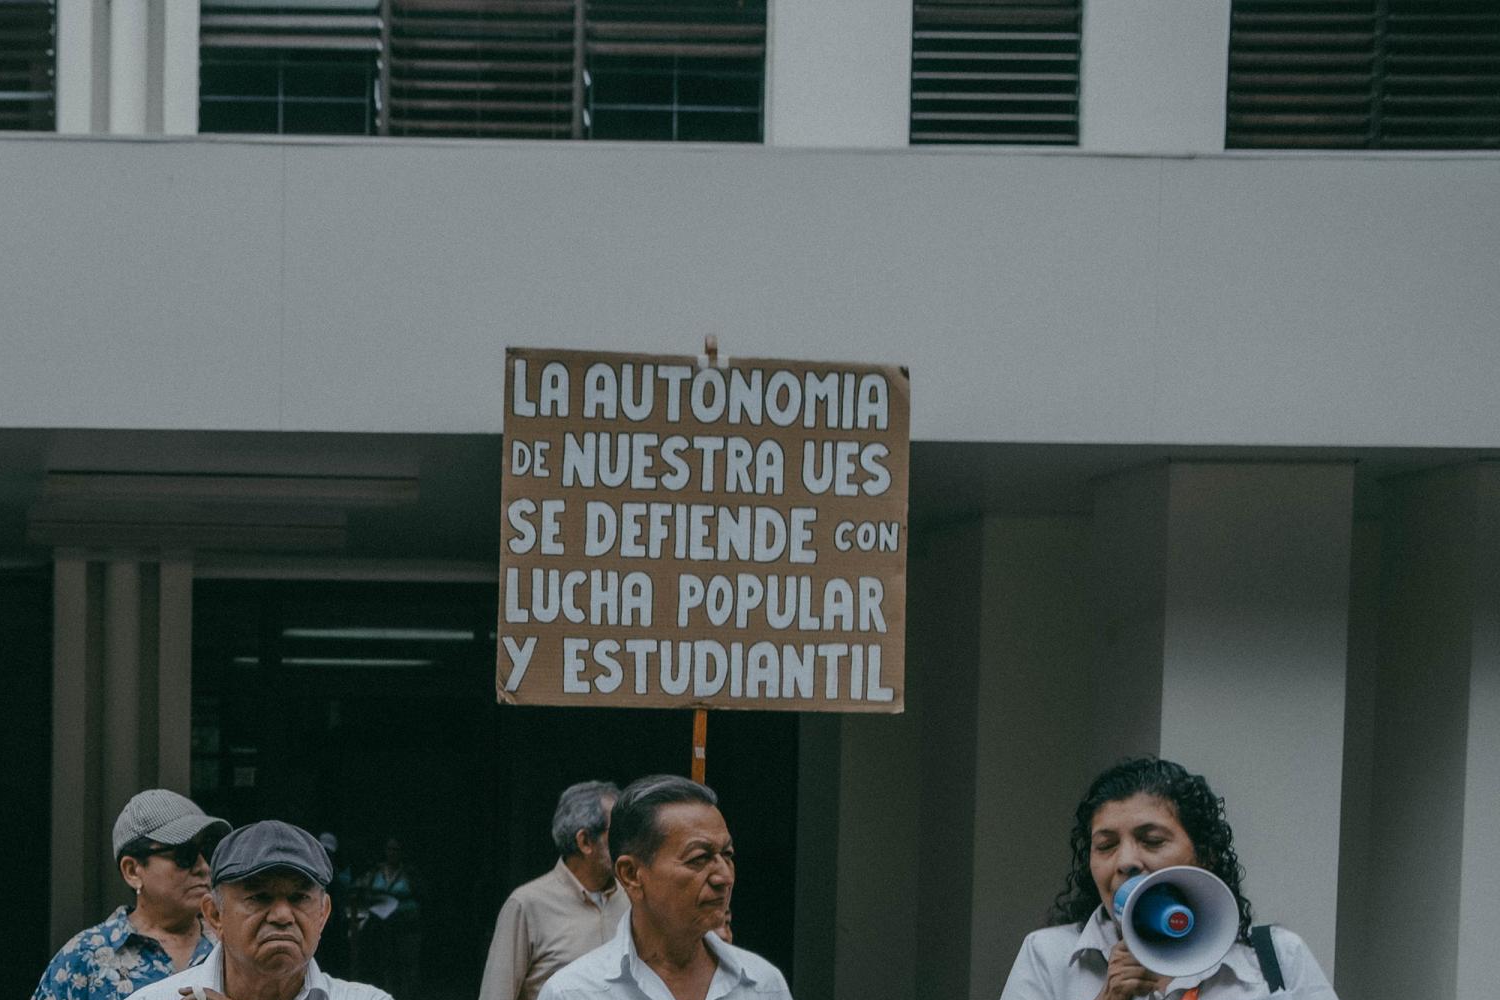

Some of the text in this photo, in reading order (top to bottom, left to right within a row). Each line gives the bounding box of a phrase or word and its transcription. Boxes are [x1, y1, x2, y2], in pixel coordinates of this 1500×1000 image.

[513, 359, 889, 430] LA AUTONOMIA
[511, 432, 891, 497] DE NUESTRA UES
[507, 498, 900, 563] SE DEFIENDE CON
[505, 567, 887, 634] LUCHA POPULAR
[502, 636, 895, 702] Y ESTUDIANTIL
